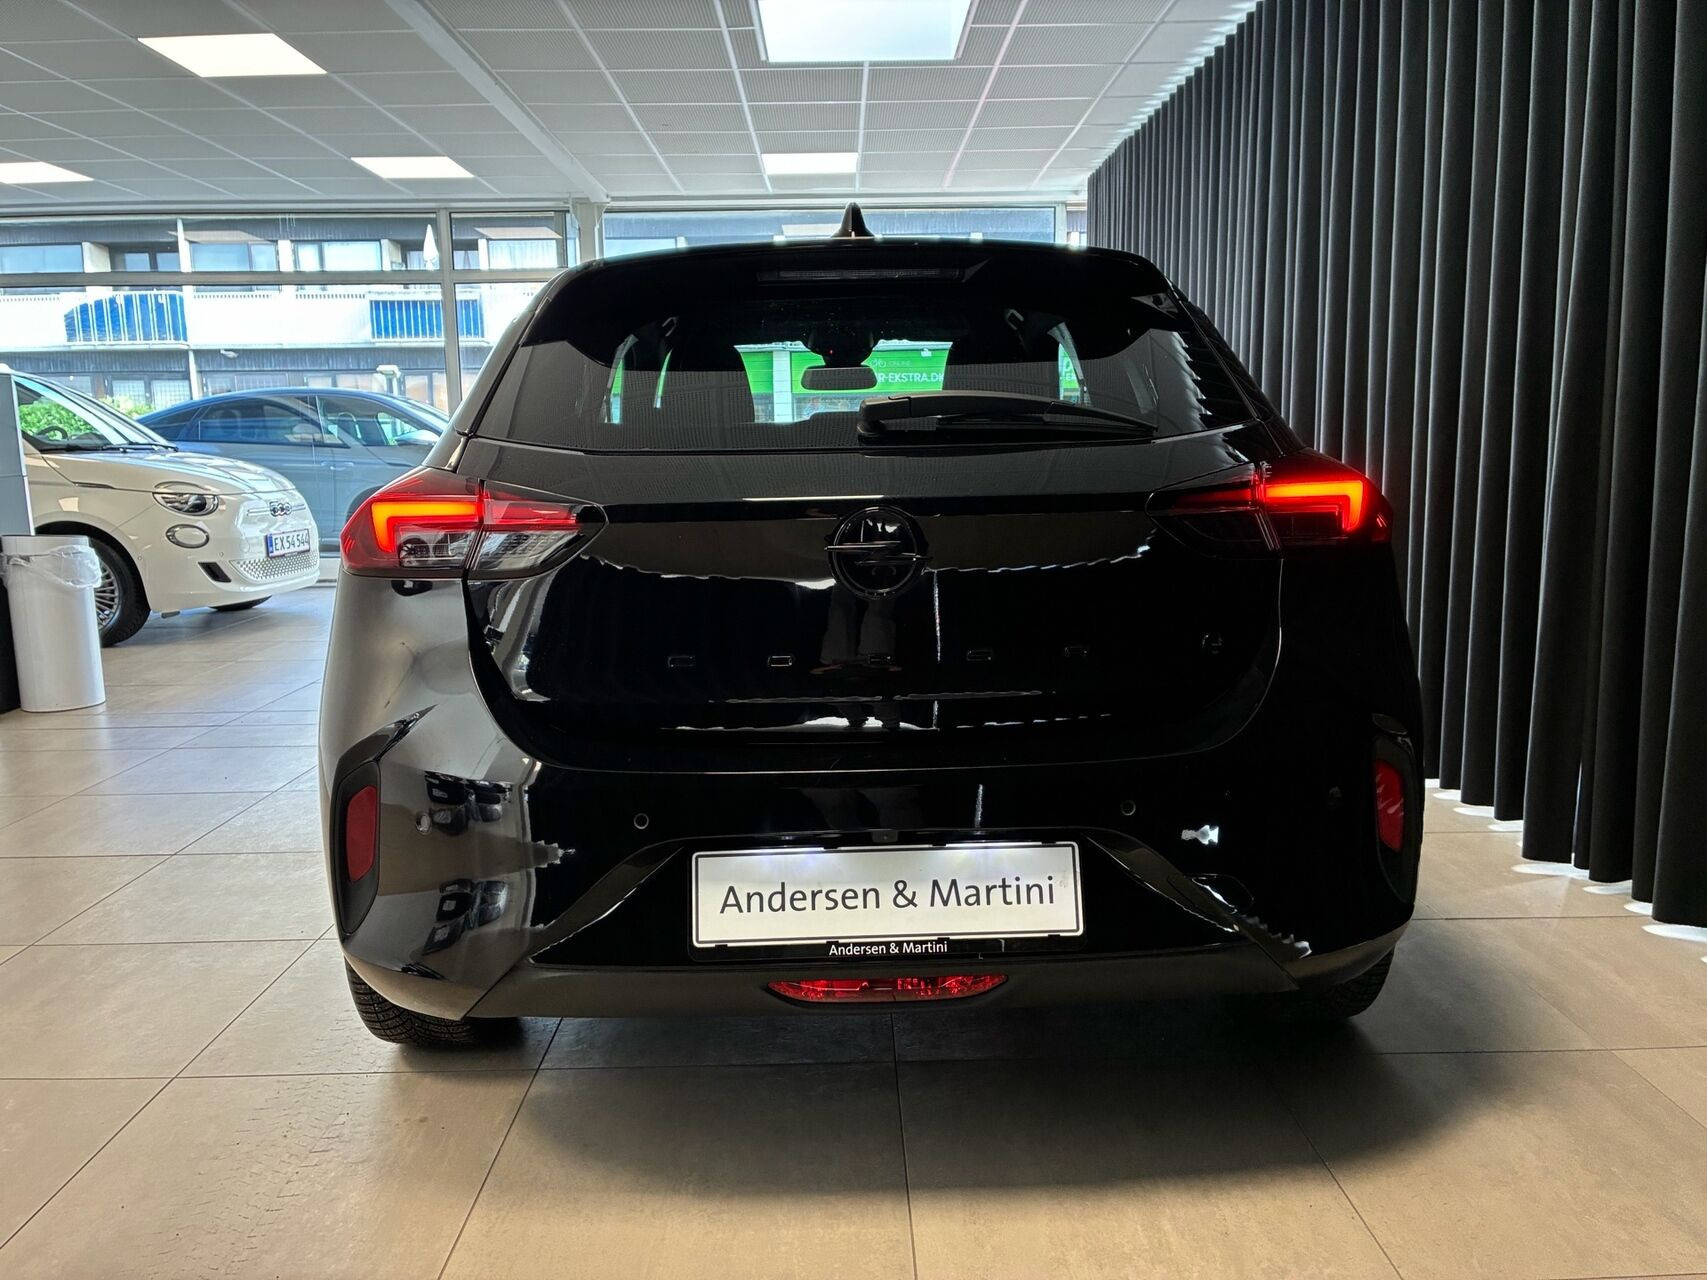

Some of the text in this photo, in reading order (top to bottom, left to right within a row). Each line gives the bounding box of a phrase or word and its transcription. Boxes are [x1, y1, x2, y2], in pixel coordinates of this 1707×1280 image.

[877, 372, 944, 383] R-EKSTRA.DK
[719, 875, 1054, 914] Andersen & Martini
[828, 940, 948, 956] Andersen & Martini
